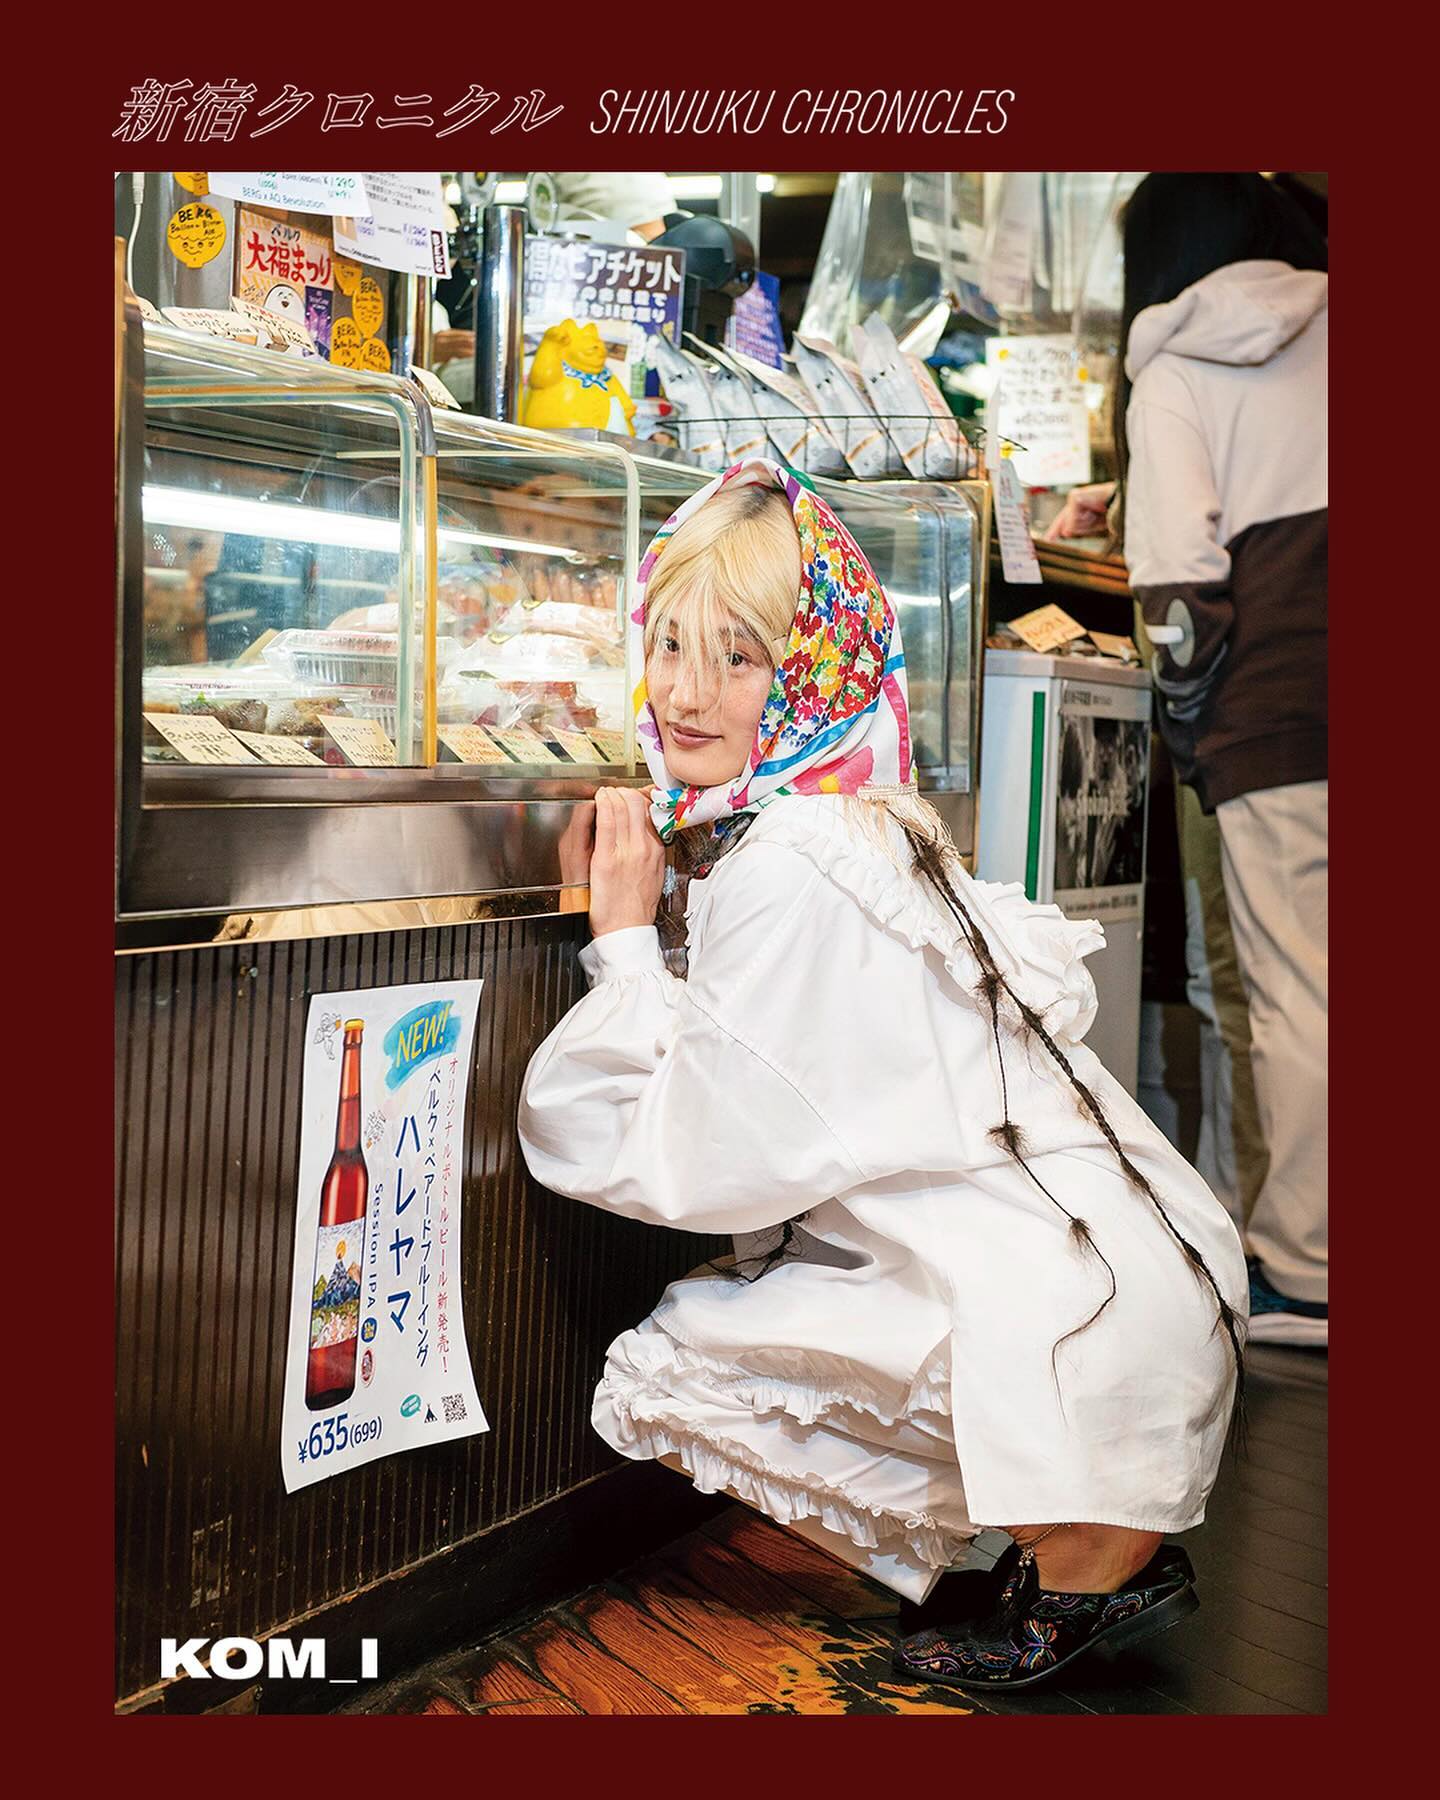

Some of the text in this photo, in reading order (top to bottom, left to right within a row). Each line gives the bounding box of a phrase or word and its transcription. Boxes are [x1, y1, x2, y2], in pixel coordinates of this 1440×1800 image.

[178, 207, 213, 223] BERG
[245, 230, 333, 286] 大福まつり
[395, 1003, 451, 1067] NEW!
[387, 1114, 422, 1334] ハレヤマ
[367, 1273, 378, 1309] IPA
